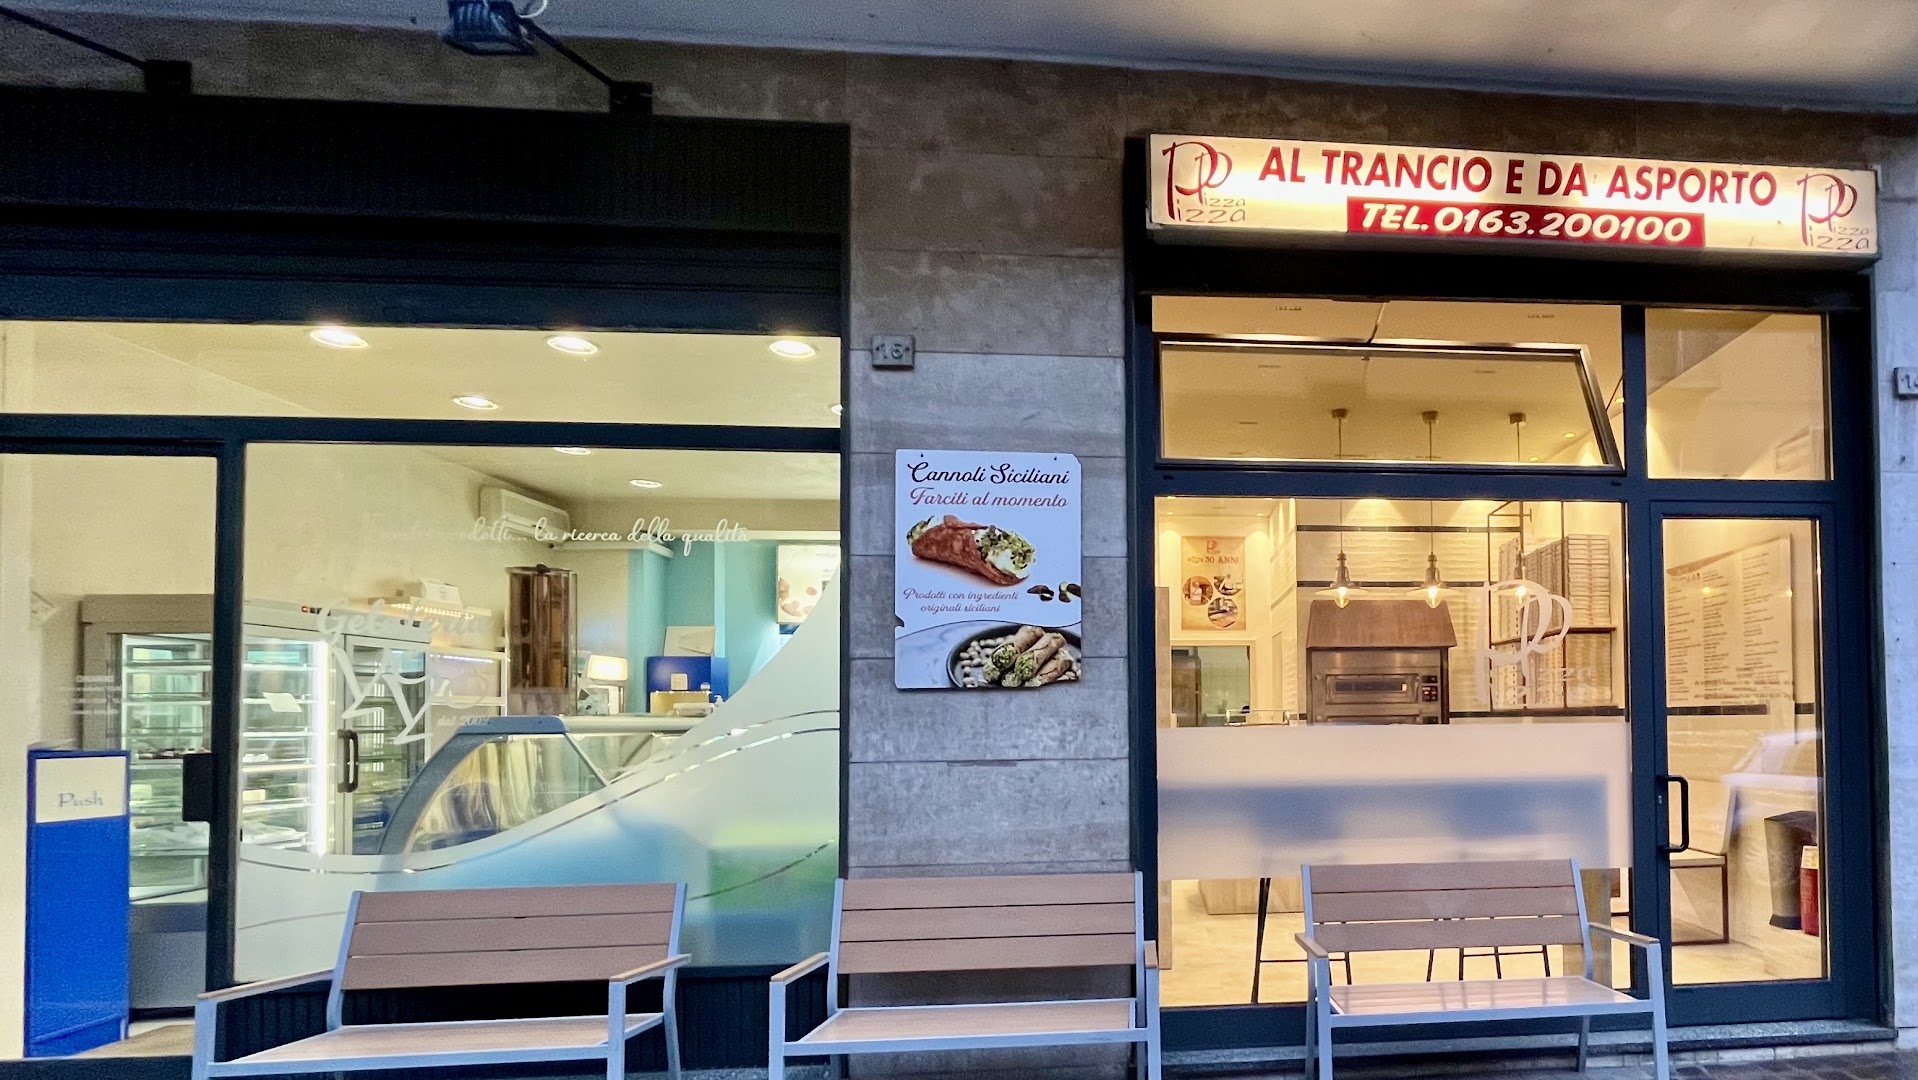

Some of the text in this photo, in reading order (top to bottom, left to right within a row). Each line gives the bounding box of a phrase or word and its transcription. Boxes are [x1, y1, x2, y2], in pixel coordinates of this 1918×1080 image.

[1258, 146, 1777, 206] AL TRANCIO E DA ASPORTO
[907, 461, 1069, 485] Cannoli Siciliani
[910, 486, 1068, 508] Farciti al momento
[534, 516, 557, 542] la
[561, 528, 623, 542] ricerca
[627, 516, 676, 543] della
[681, 518, 750, 557] qualità
[903, 587, 1019, 603] Prodotti con ingredienti
[920, 603, 1001, 615] originali siciliani
[57, 790, 104, 808] Push
